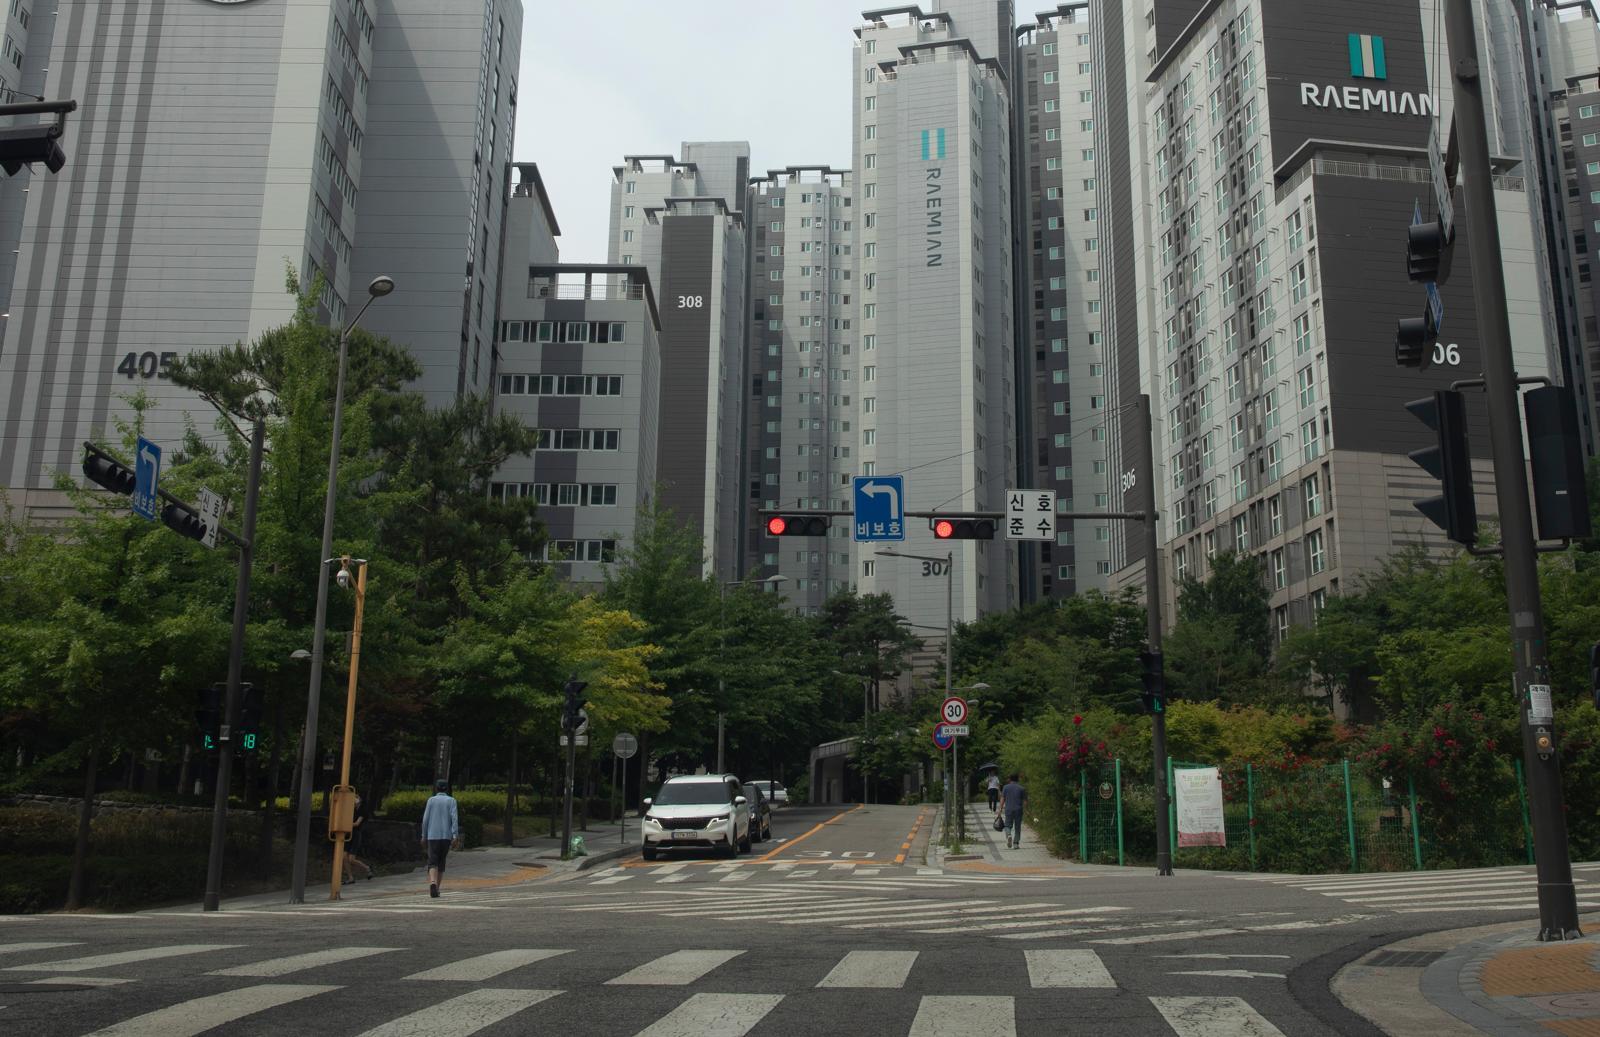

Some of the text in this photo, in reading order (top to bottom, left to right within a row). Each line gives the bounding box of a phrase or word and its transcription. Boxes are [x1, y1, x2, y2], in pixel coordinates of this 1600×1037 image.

[1300, 82, 1439, 117] RAEMIAN
[926, 167, 942, 267] RAEMIAN
[678, 296, 702, 308] 308
[1432, 342, 1460, 365] 06
[1122, 468, 1135, 492] 306
[857, 521, 901, 537] 비보호
[947, 705, 962, 717] 30
[244, 734, 256, 749] 18
